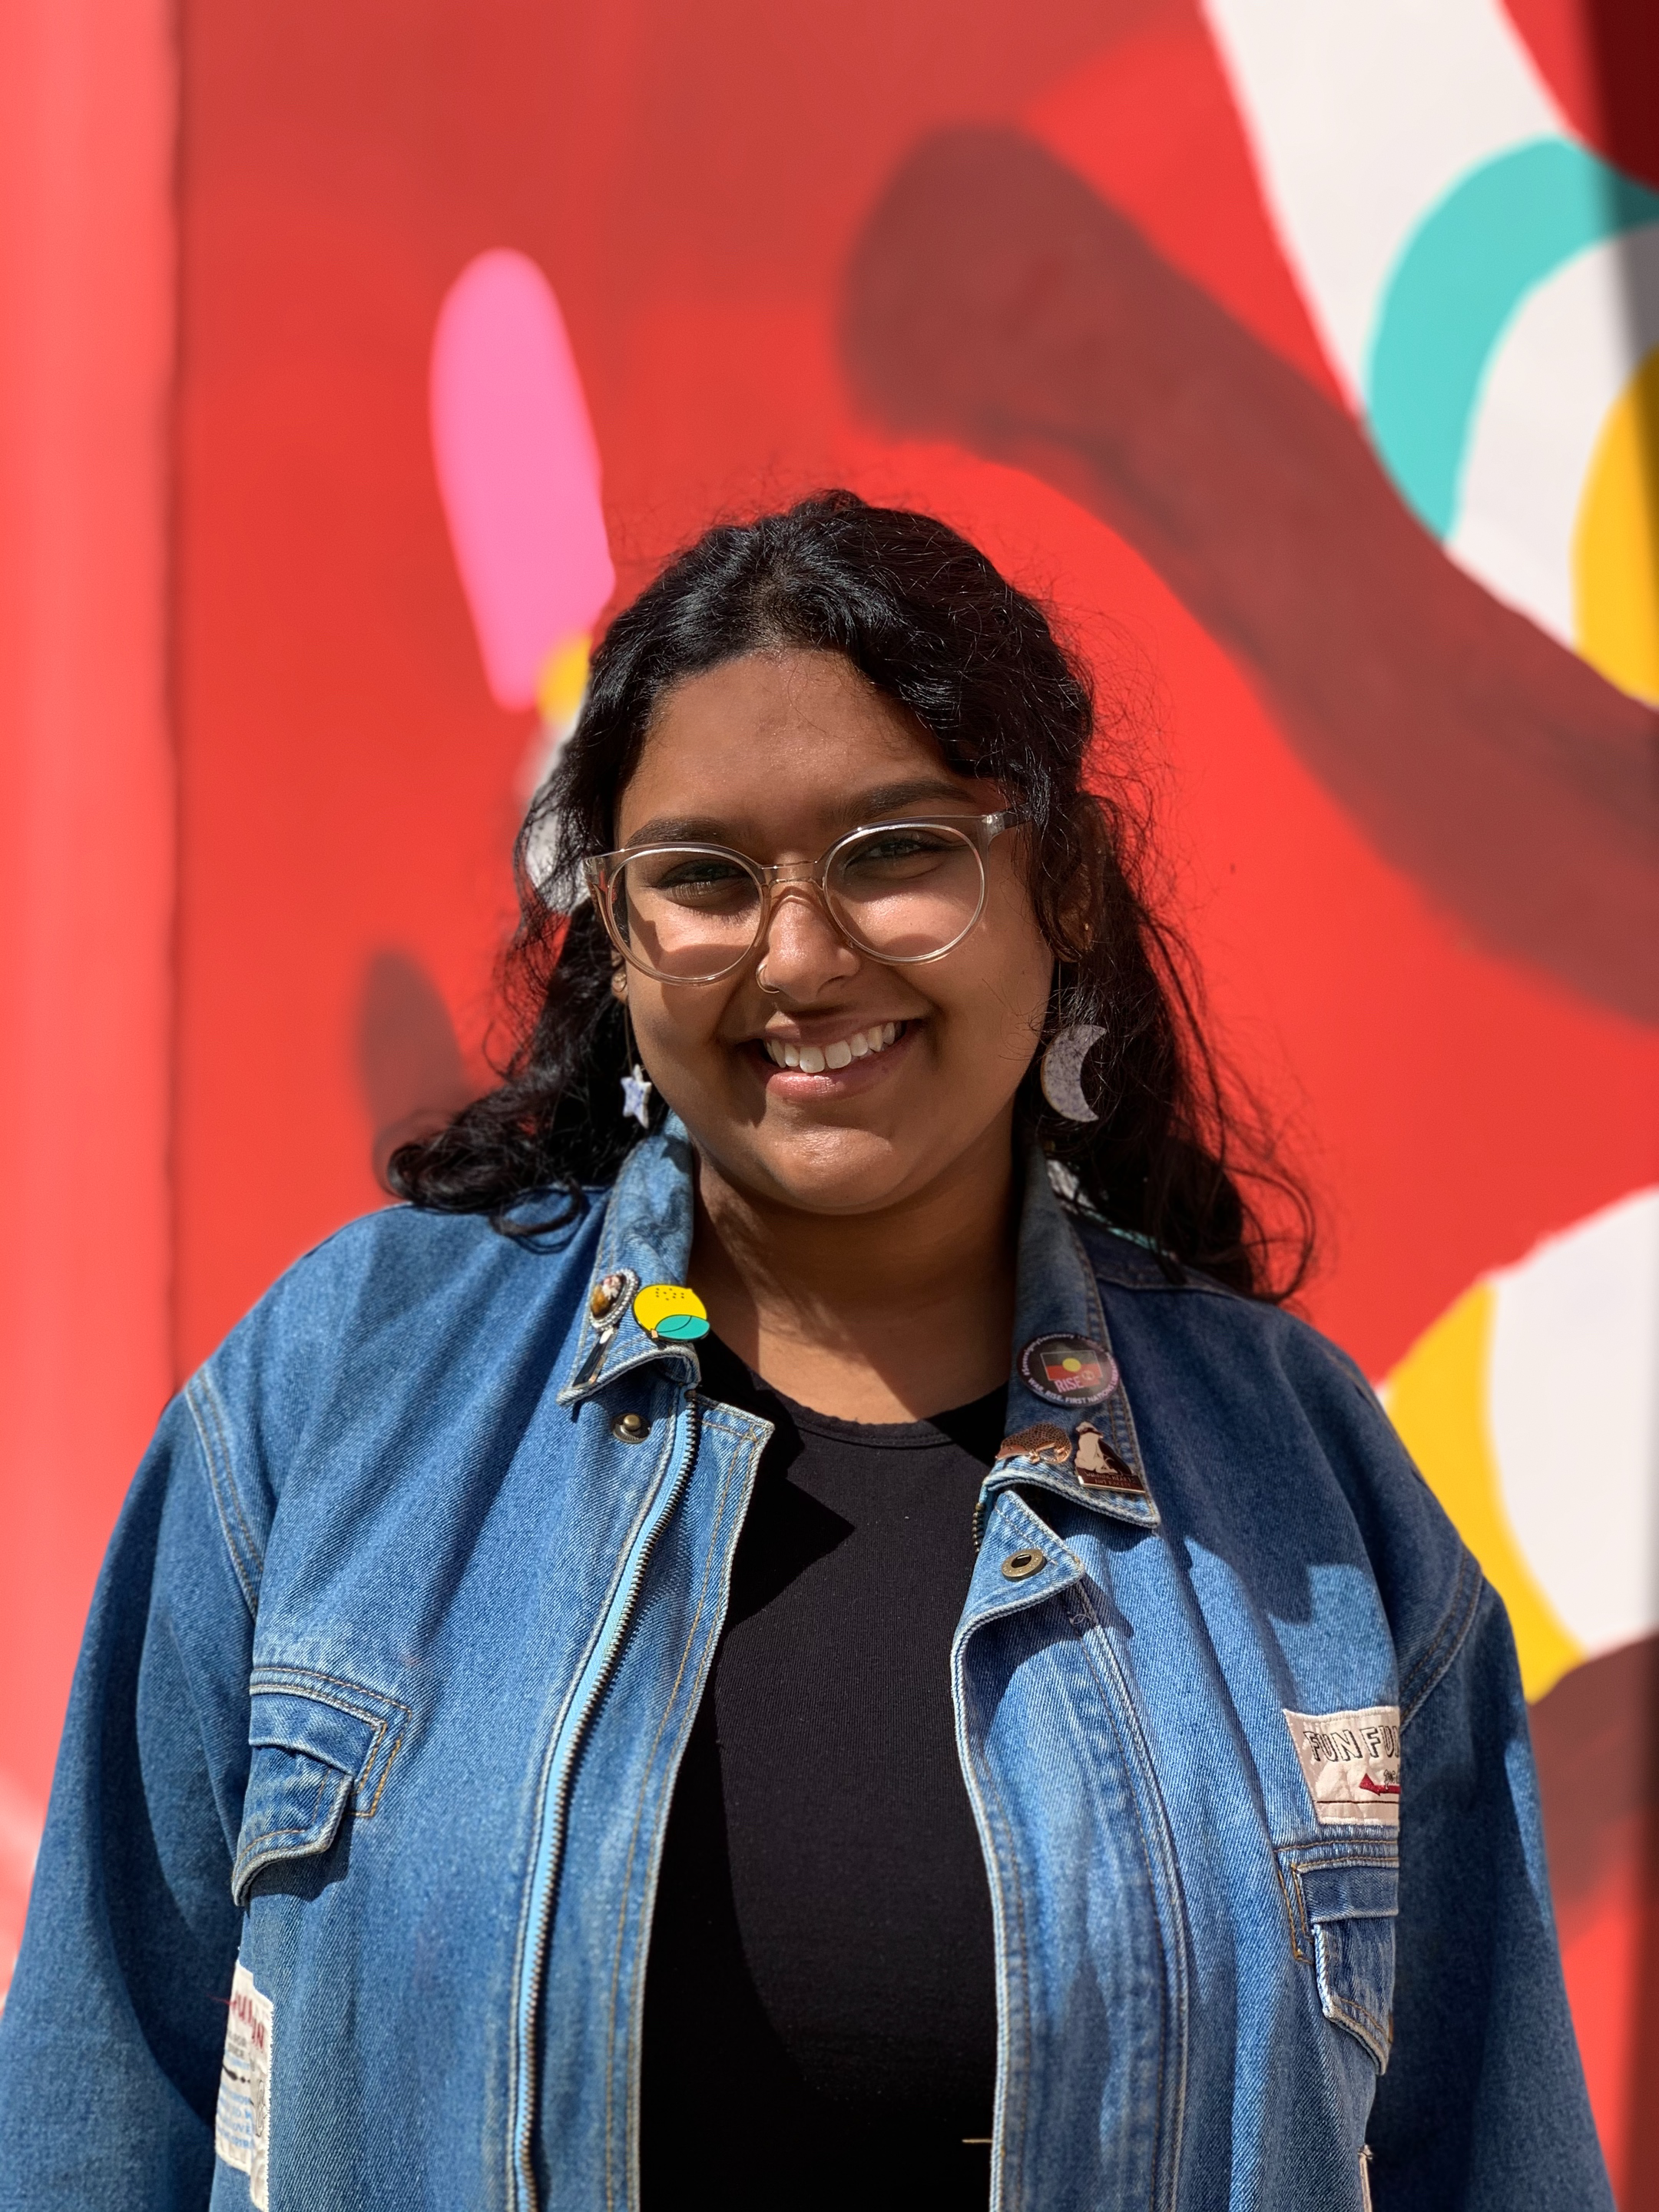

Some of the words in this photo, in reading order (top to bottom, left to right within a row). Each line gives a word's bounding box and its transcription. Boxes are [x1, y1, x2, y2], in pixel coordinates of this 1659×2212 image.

[1054, 1376, 1084, 1393] RISE
[1088, 1384, 1114, 1404] NATIONS
[1303, 1729, 1363, 1762] FUN
